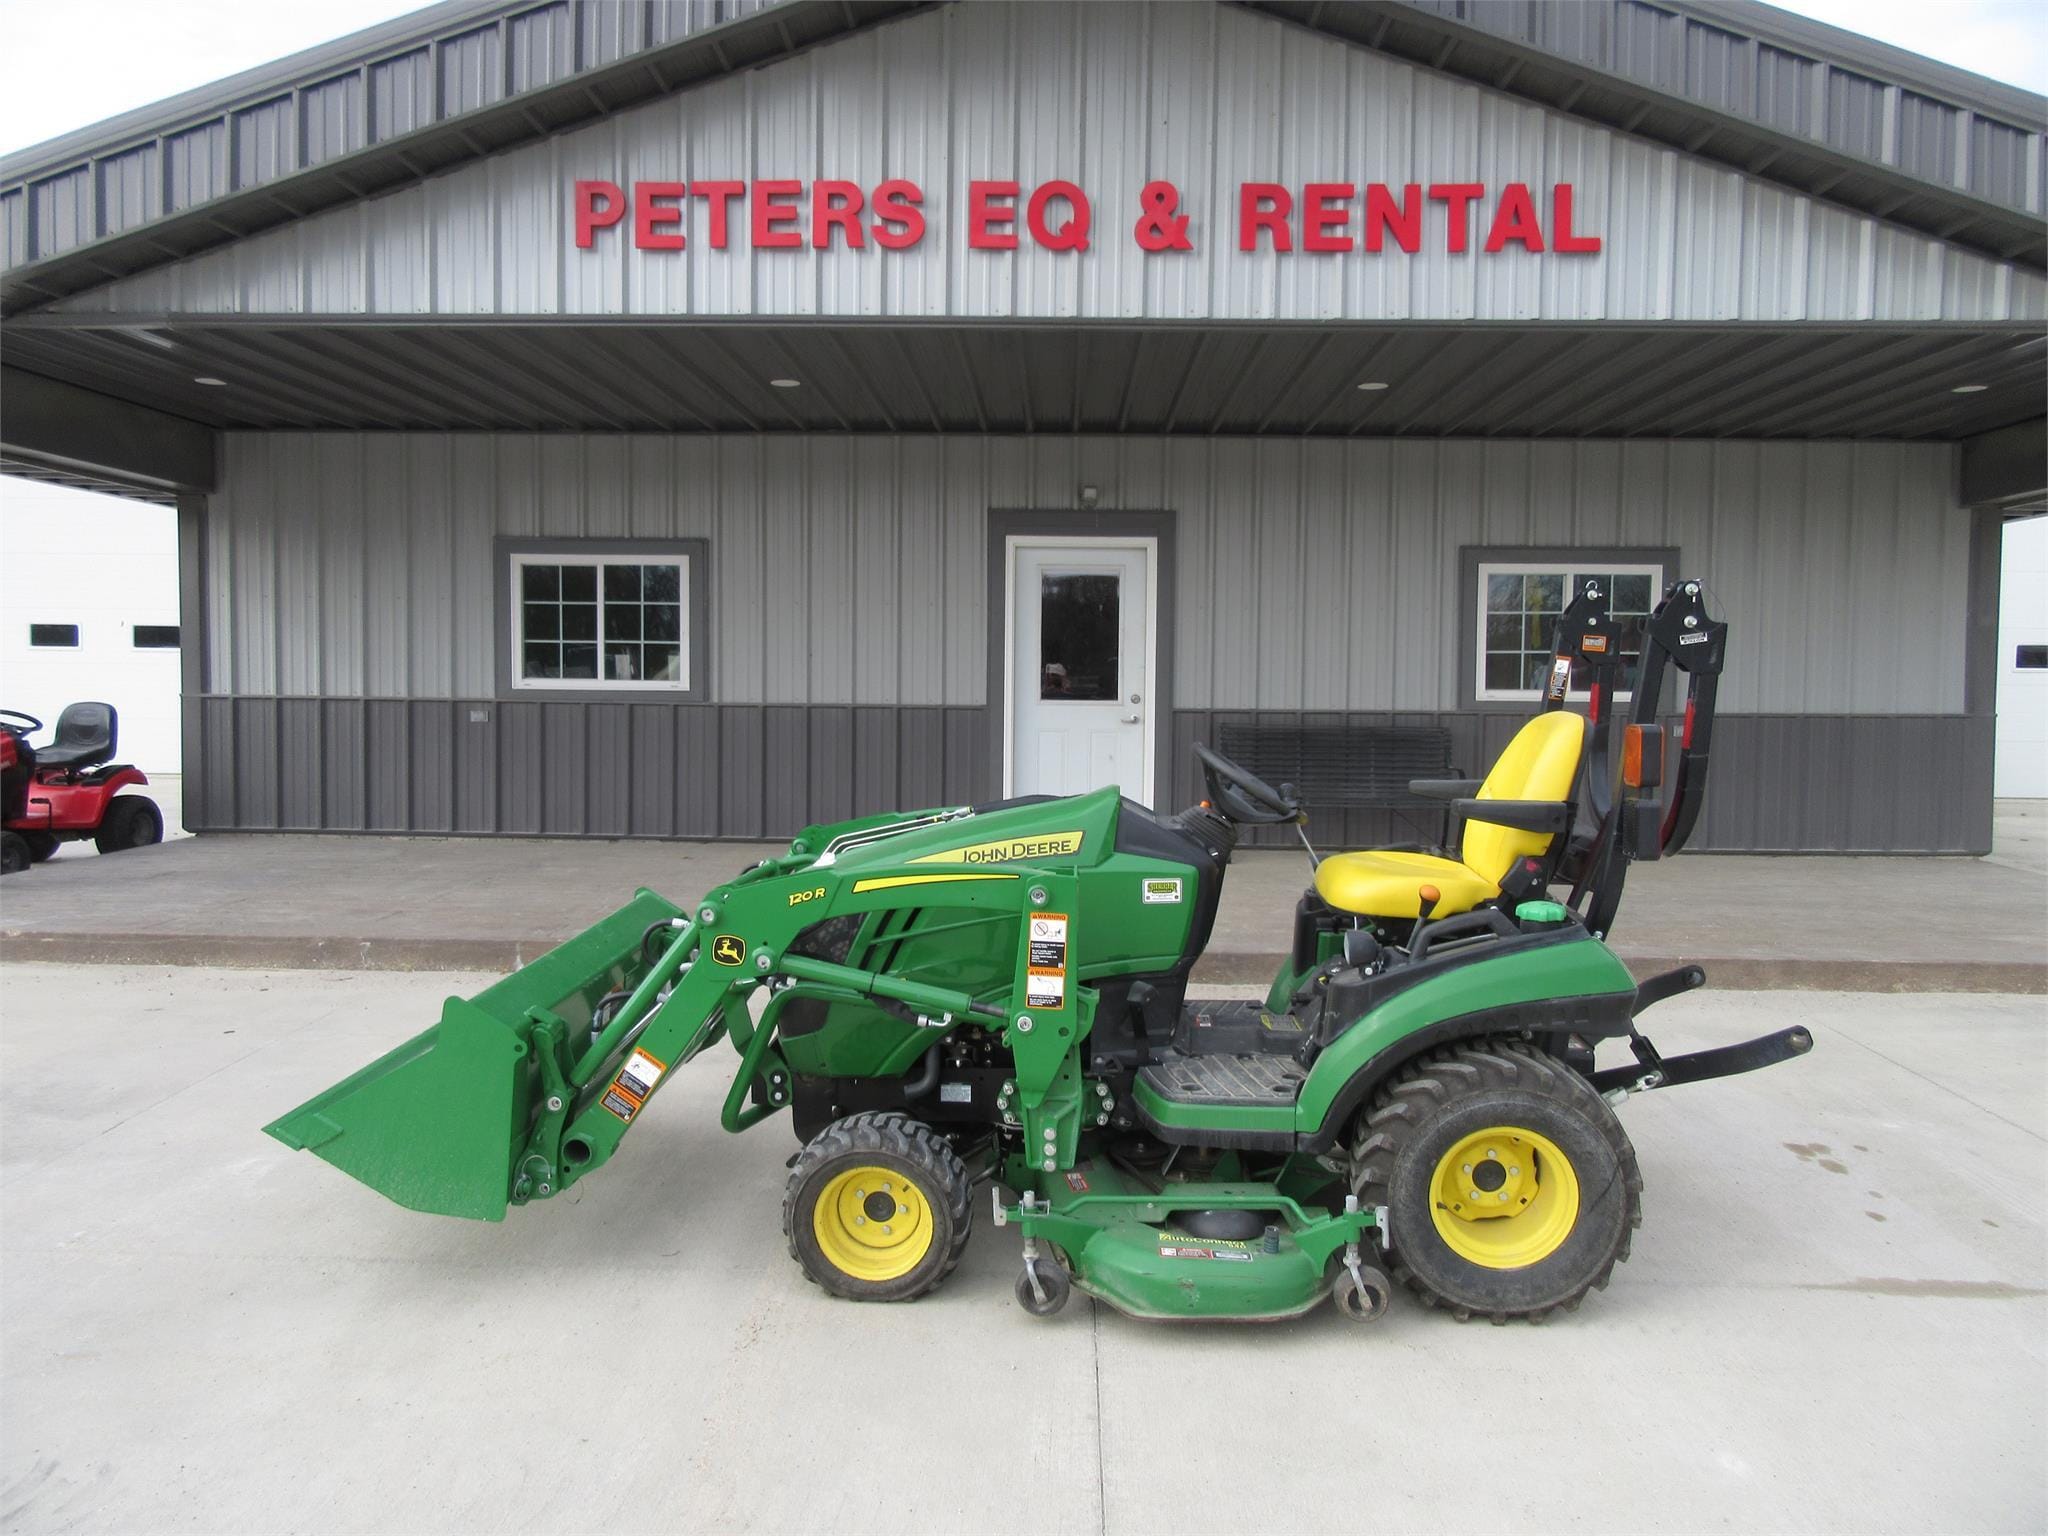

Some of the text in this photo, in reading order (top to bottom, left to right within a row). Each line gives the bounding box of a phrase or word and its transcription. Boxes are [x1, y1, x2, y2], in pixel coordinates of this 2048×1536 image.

[575, 179, 1602, 254] PETERS EQ & RENTAL
[963, 840, 1072, 864] JOHN DEERE
[788, 887, 826, 907] 120 R
[1038, 913, 1066, 921] WARNING
